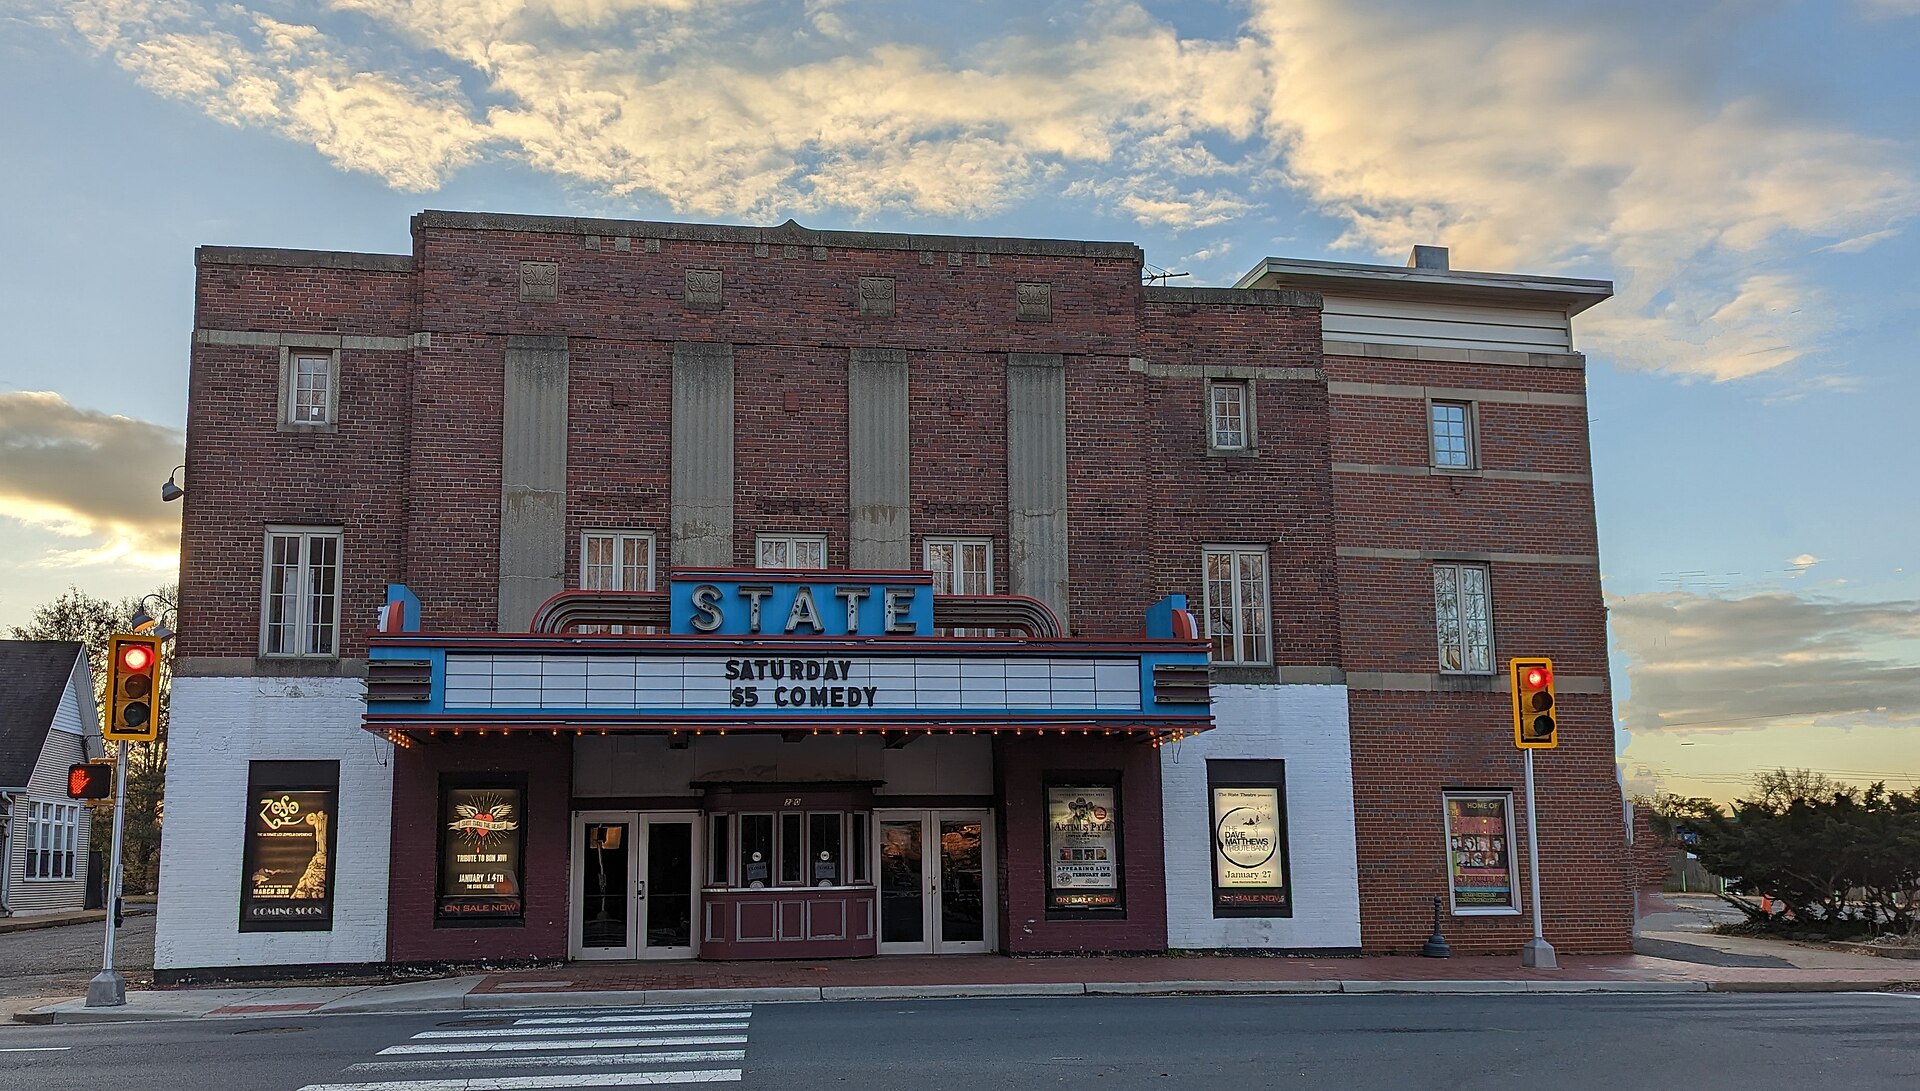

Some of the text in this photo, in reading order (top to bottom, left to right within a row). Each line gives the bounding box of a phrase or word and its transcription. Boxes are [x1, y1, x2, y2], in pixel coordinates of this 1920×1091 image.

[690, 584, 917, 634] STATE
[725, 659, 851, 681] SATURDAY
[731, 686, 878, 708] $5 COMEDY
[1054, 822, 1111, 832] ARTIMUS PYLE
[457, 854, 507, 862] TRIBUTE TO BON JOVI
[458, 873, 485, 883] JANUARY
[1225, 870, 1272, 880] January 27
[253, 907, 322, 916] COMING SOON
[444, 904, 460, 912] ON
[463, 904, 490, 912] SALE
